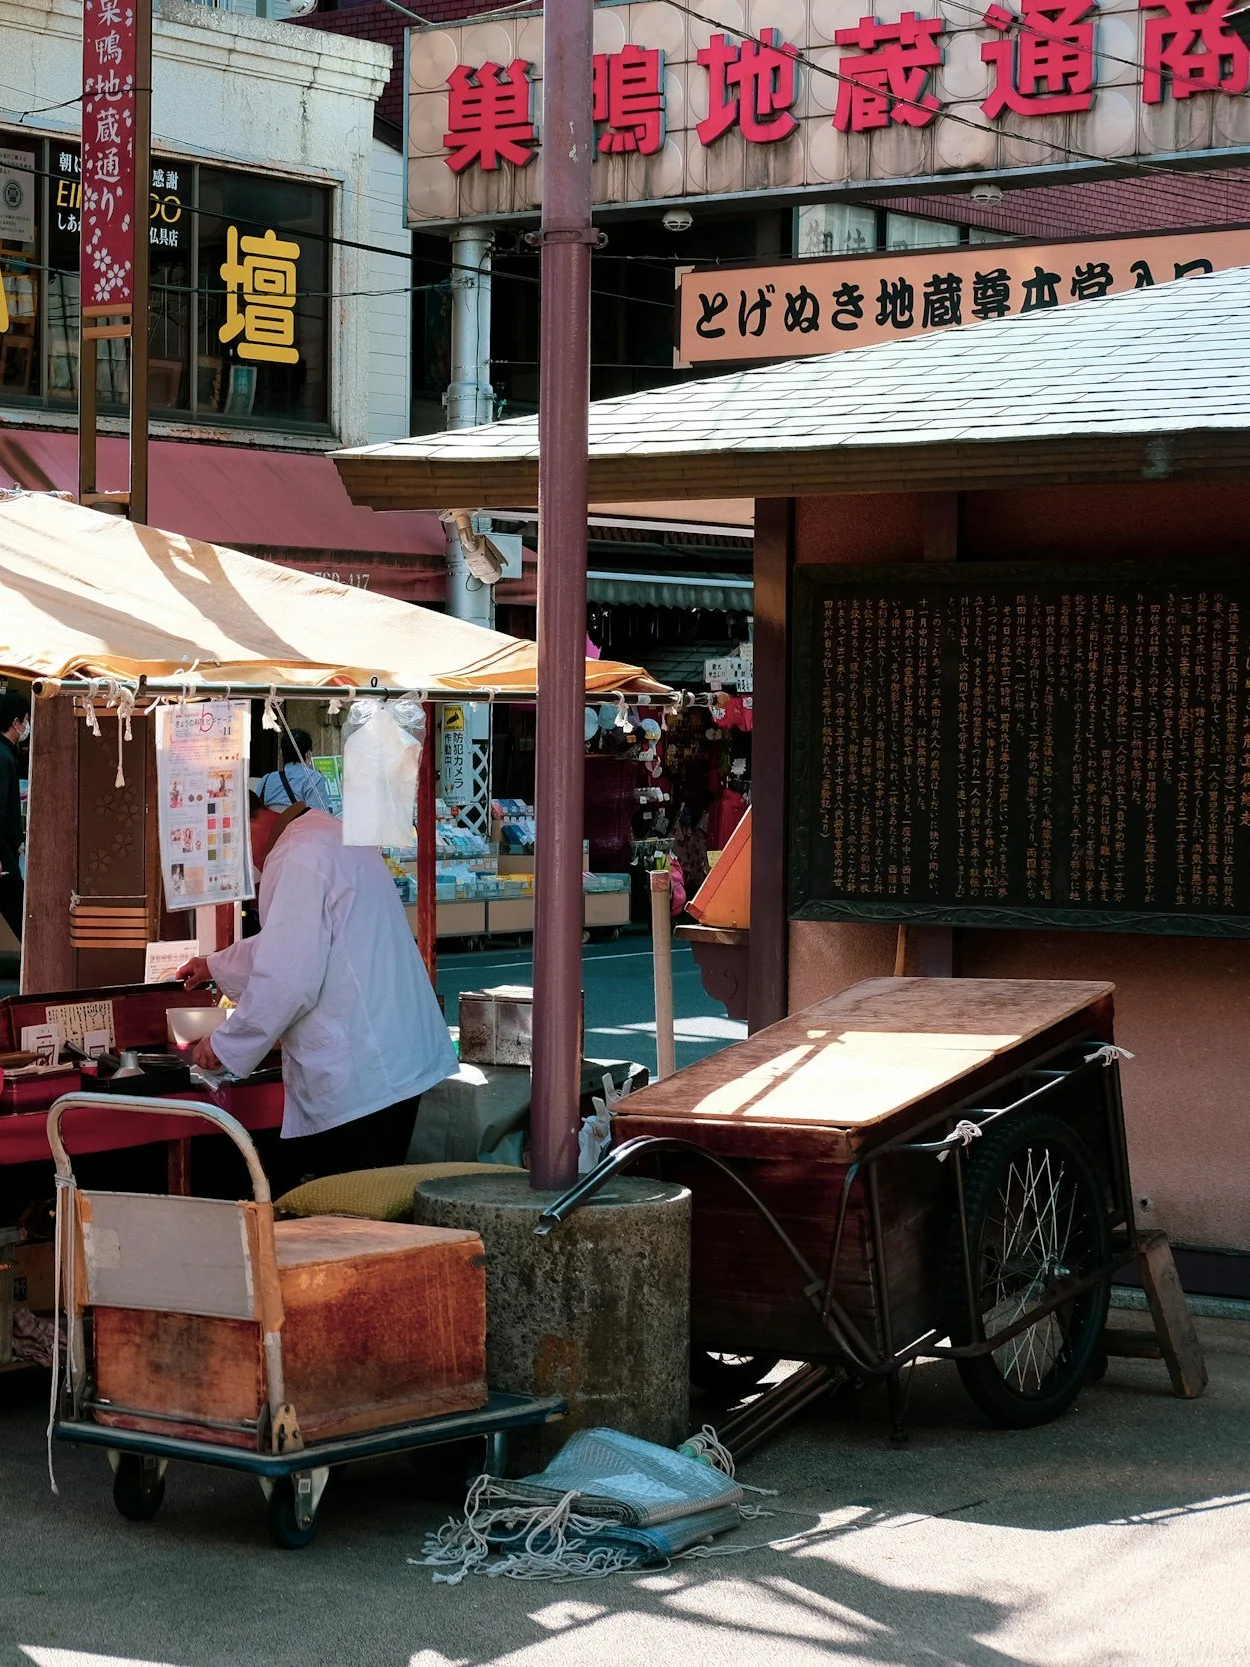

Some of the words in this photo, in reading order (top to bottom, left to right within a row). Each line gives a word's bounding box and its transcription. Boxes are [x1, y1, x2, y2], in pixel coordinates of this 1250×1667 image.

[453, 733, 464, 789] 防犯カメラ
